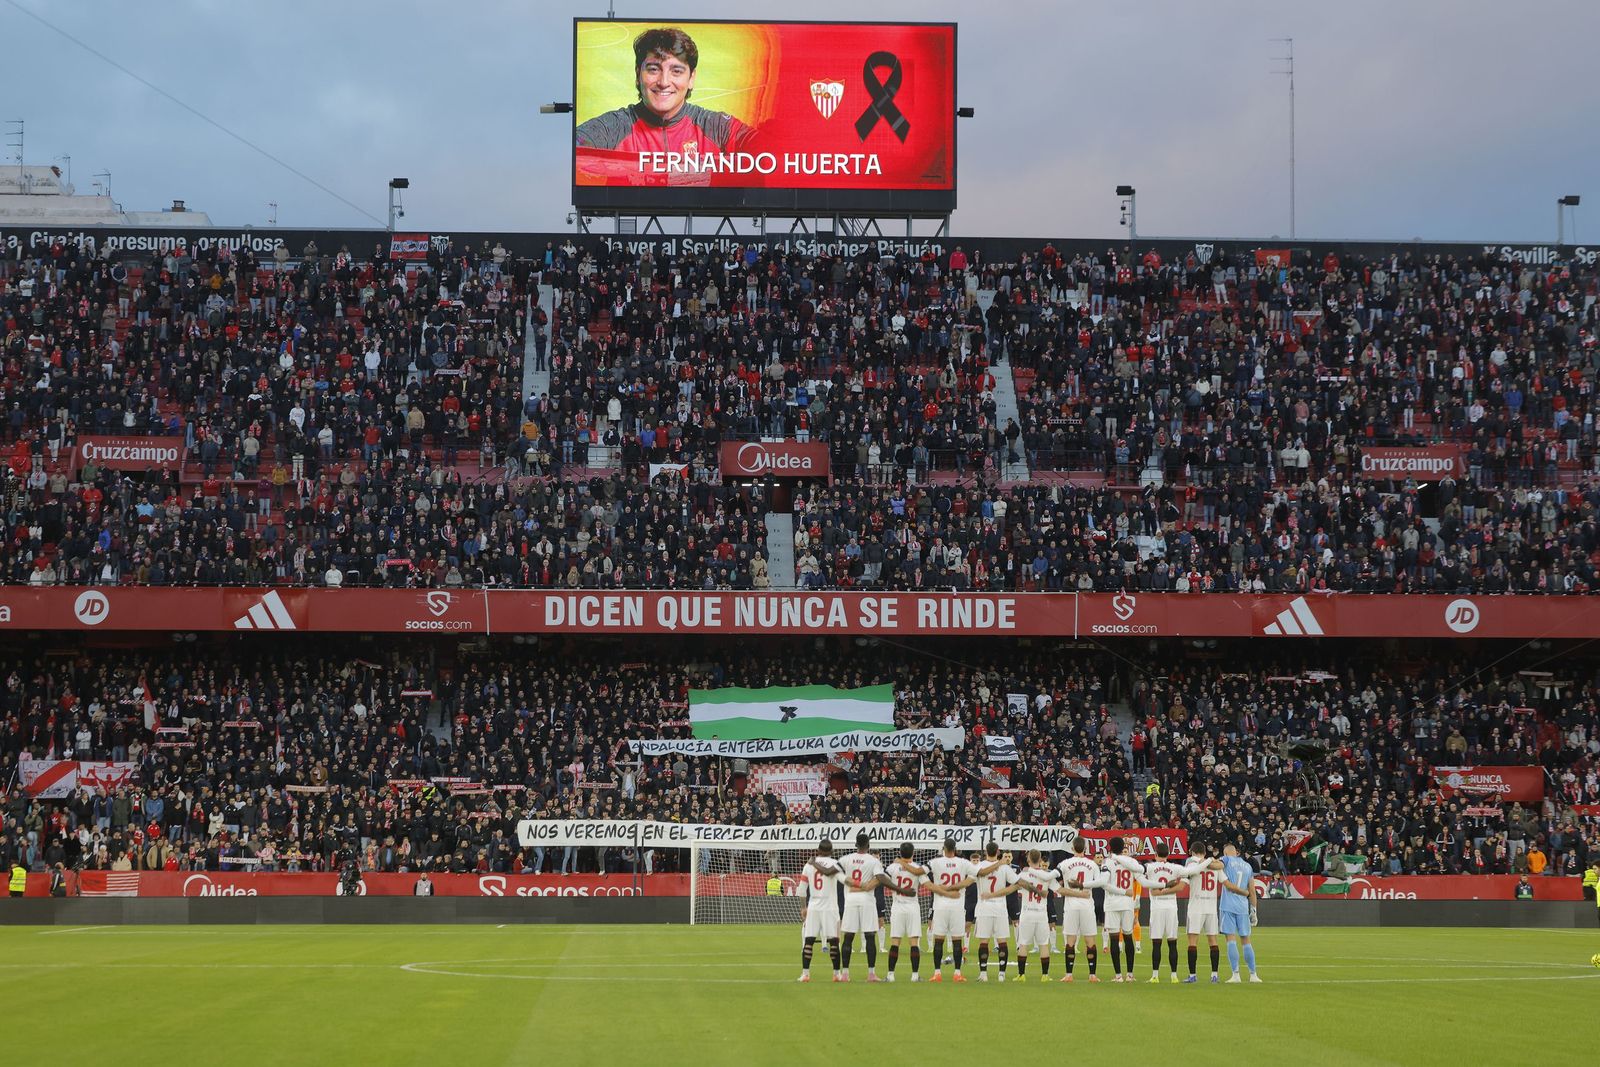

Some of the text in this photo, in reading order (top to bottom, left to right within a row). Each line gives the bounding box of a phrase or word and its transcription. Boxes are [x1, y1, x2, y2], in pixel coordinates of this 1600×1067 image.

[639, 152, 882, 175] FERNANDO HUERTA
[628, 242, 656, 255] ver
[662, 239, 677, 255] al
[1501, 246, 1559, 264] Sevilla
[82, 441, 178, 464] Cruzcampo
[748, 452, 812, 469] Midea
[1361, 453, 1454, 474] Cruzcampo
[79, 599, 105, 616] JD
[545, 596, 1016, 631] DICEN QUE NUNCA SE RINDE
[1450, 606, 1475, 625] JD
[718, 740, 774, 754] ENTERA
[829, 734, 860, 748] CON
[864, 733, 936, 748] VOSOTROS
[1470, 775, 1503, 784] NUNCA
[527, 823, 558, 840] NOS
[564, 823, 636, 840] VEREMOS
[643, 824, 665, 840] EN
[669, 825, 688, 840] EL
[1001, 827, 1075, 843] FERNANDO
[814, 869, 824, 890] 6
[988, 876, 998, 893] 7
[1115, 869, 1132, 890] 18
[1200, 871, 1216, 891] 16
